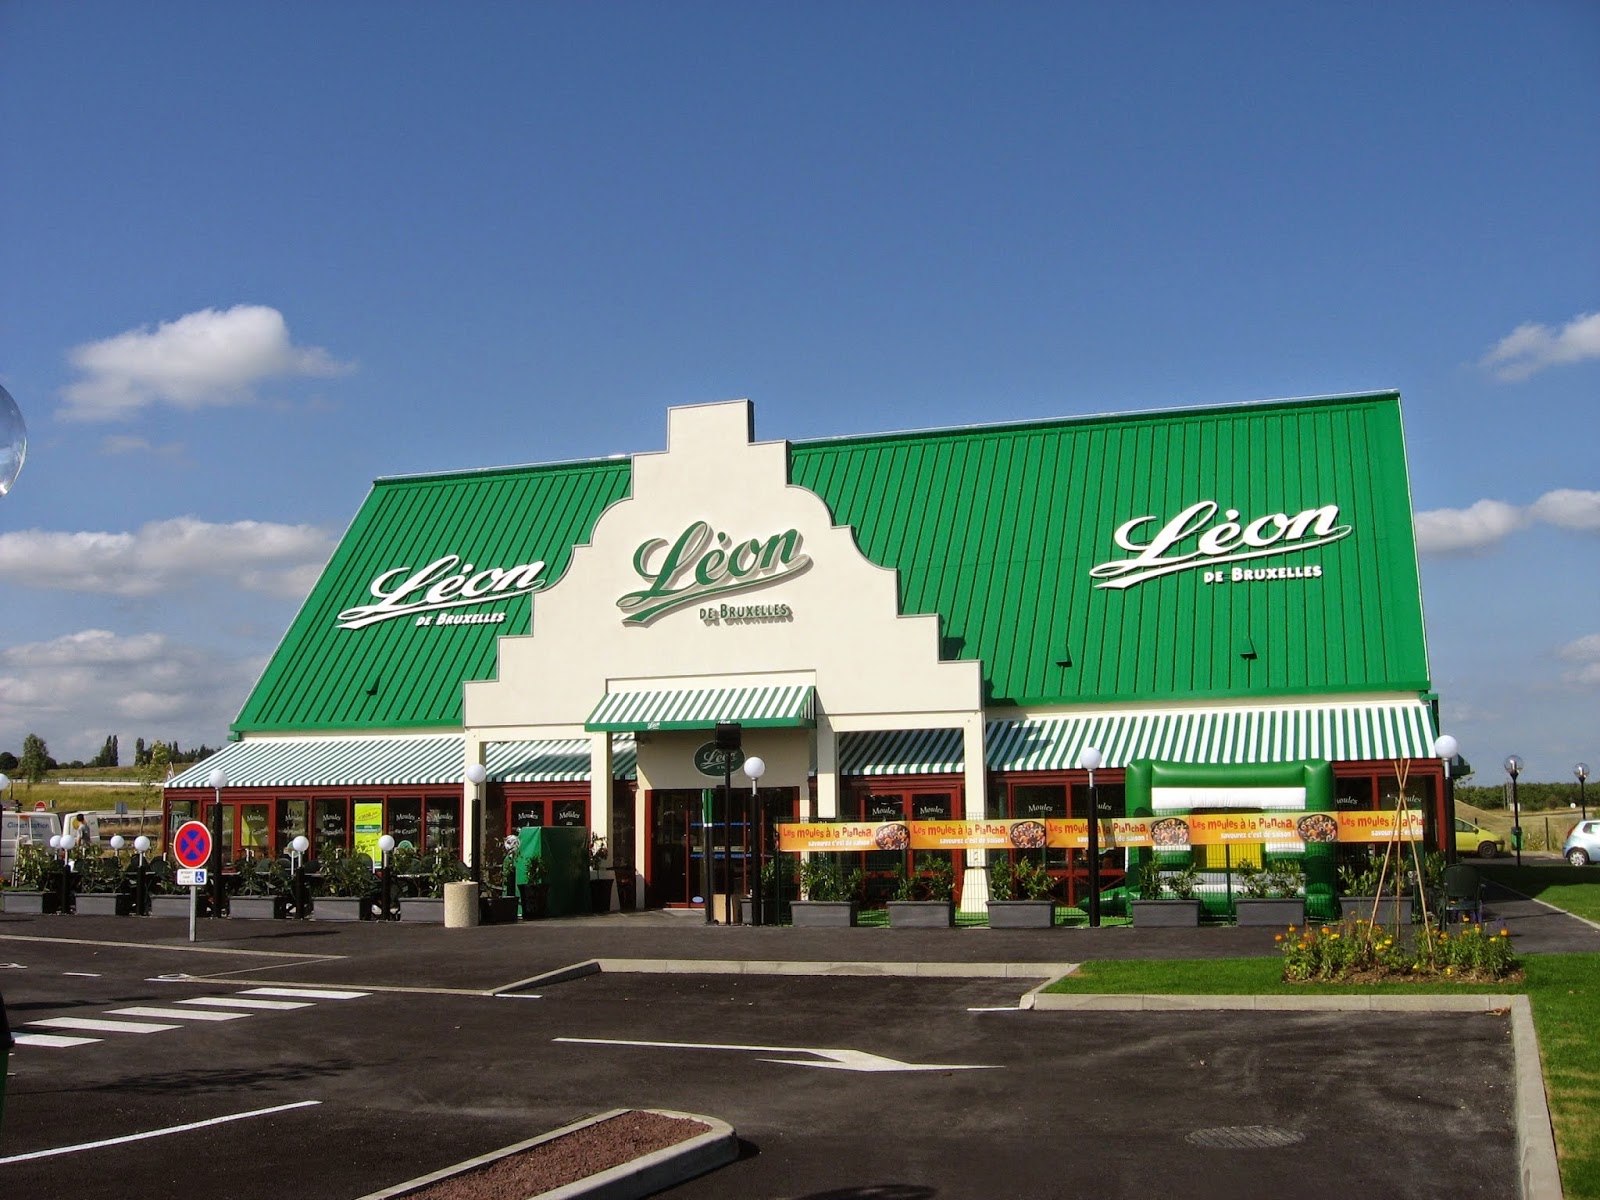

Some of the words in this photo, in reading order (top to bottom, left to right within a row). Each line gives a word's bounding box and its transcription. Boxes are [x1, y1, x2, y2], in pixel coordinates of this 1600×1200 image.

[1089, 500, 1352, 589] Léon
[615, 520, 810, 623] Léon
[1231, 565, 1323, 582] BRUXELLES
[335, 554, 546, 629] Léon
[720, 603, 791, 619] BRUXELLES
[436, 612, 506, 626] BRUXELLES
[872, 807, 896, 816] Moules
[920, 806, 944, 815] Moules
[1028, 803, 1053, 812] Moules
[1191, 819, 1206, 830] Les
[1207, 818, 1238, 830] moules
[1248, 819, 1256, 829] la
[1259, 817, 1294, 829] Plancha,
[1341, 815, 1355, 827] Les
[1357, 815, 1389, 827] moules
[783, 828, 795, 838] Les
[797, 828, 824, 838] moules
[833, 828, 839, 838] la
[913, 825, 926, 835] Les
[928, 825, 956, 836] moules
[965, 825, 973, 835] la
[975, 824, 1008, 835] Plancha,
[1049, 824, 1062, 834] Les
[1064, 823, 1089, 834] moule
[1113, 822, 1149, 834] Plancha,
